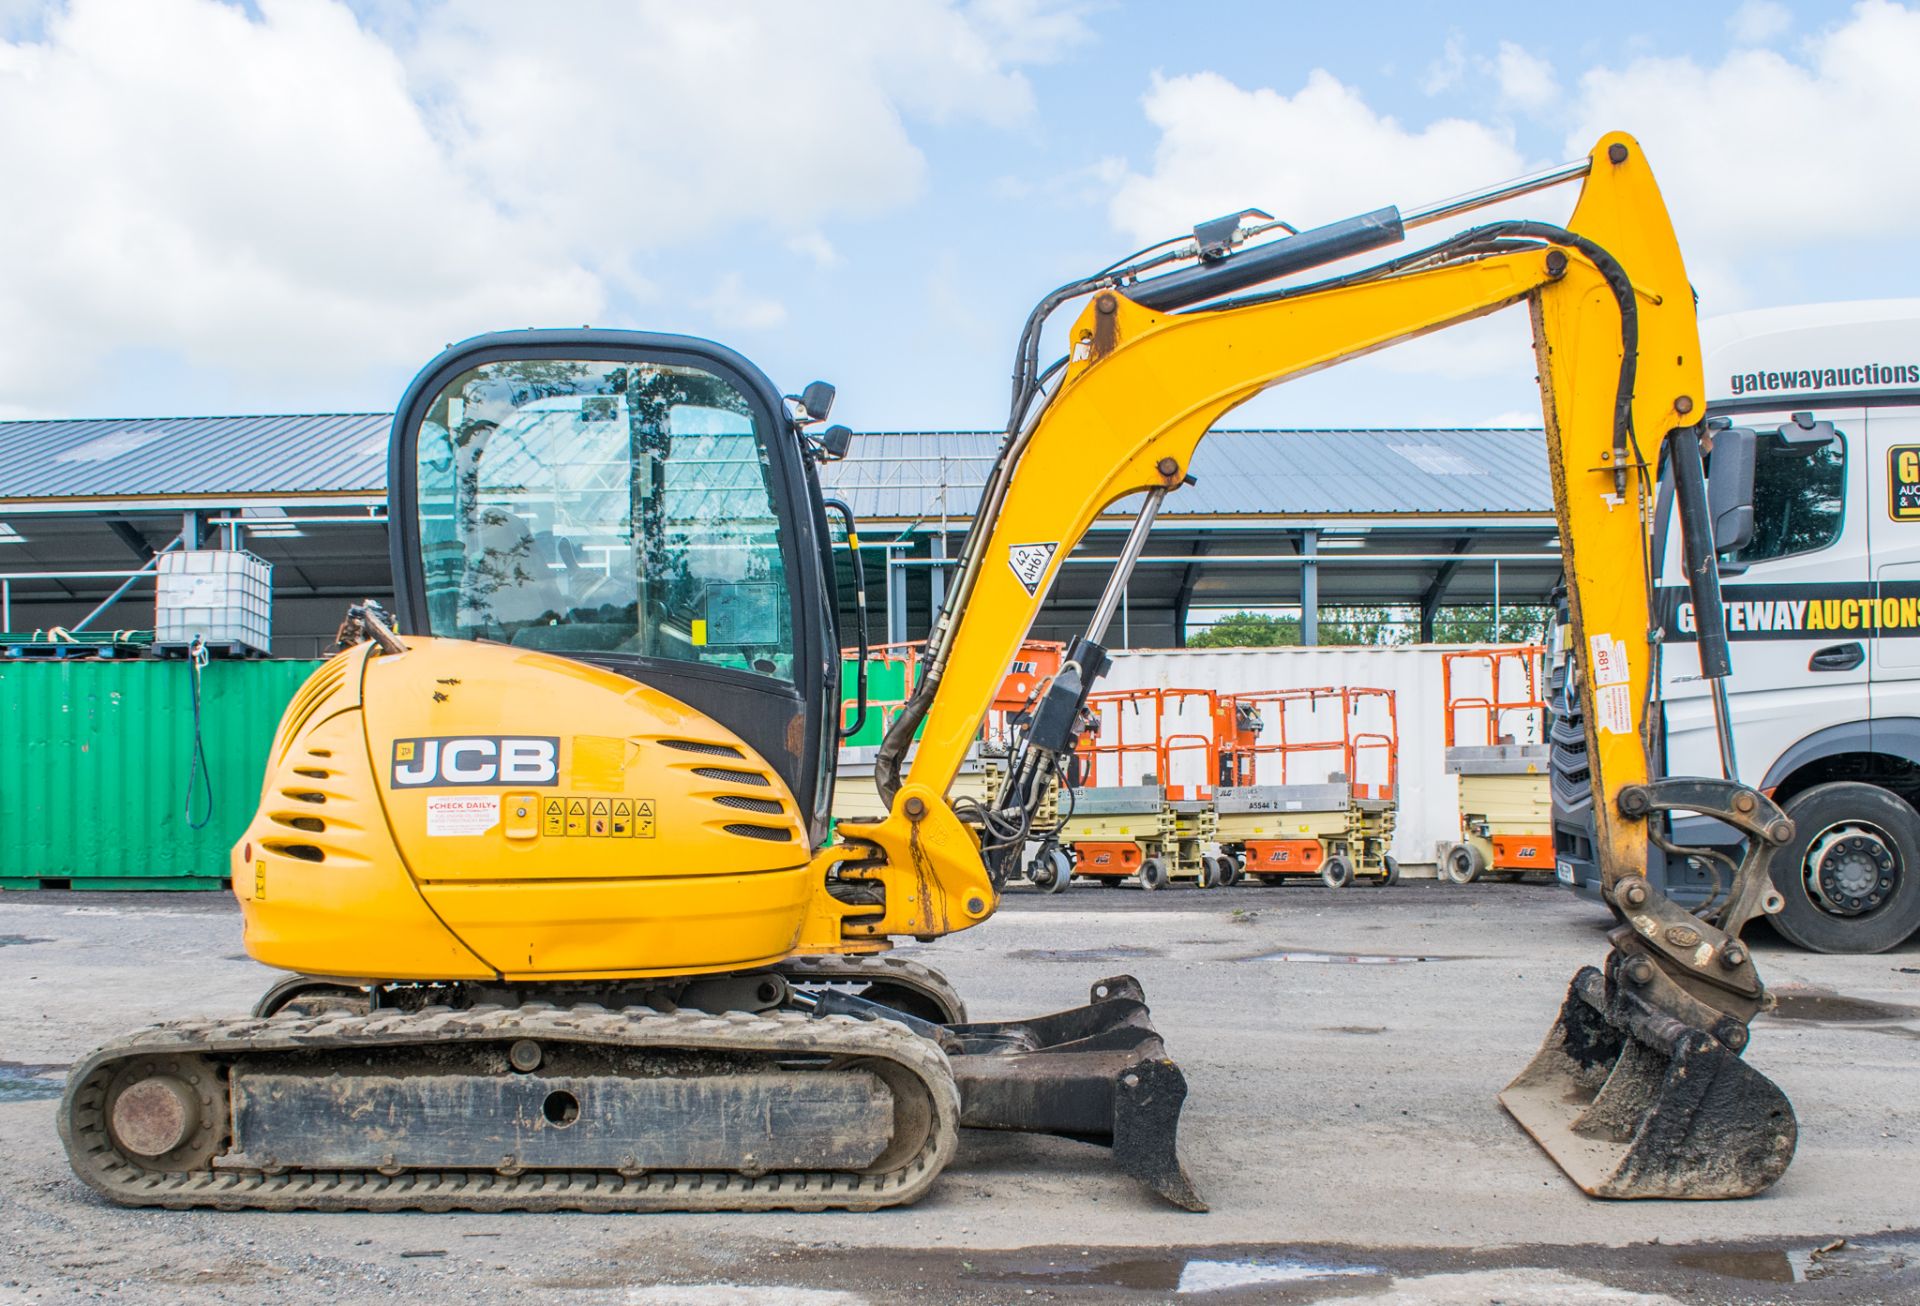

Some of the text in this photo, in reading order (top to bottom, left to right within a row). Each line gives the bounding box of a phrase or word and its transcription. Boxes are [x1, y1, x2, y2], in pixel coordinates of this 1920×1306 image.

[1731, 364, 1920, 395] gatewayauctions
[1899, 451, 1920, 484] G
[1597, 650, 1610, 671] 681
[395, 740, 556, 785] JCB
[434, 801, 492, 810] CHECK DAILY
[1270, 851, 1289, 861] JLG
[1518, 847, 1537, 857] JLG
